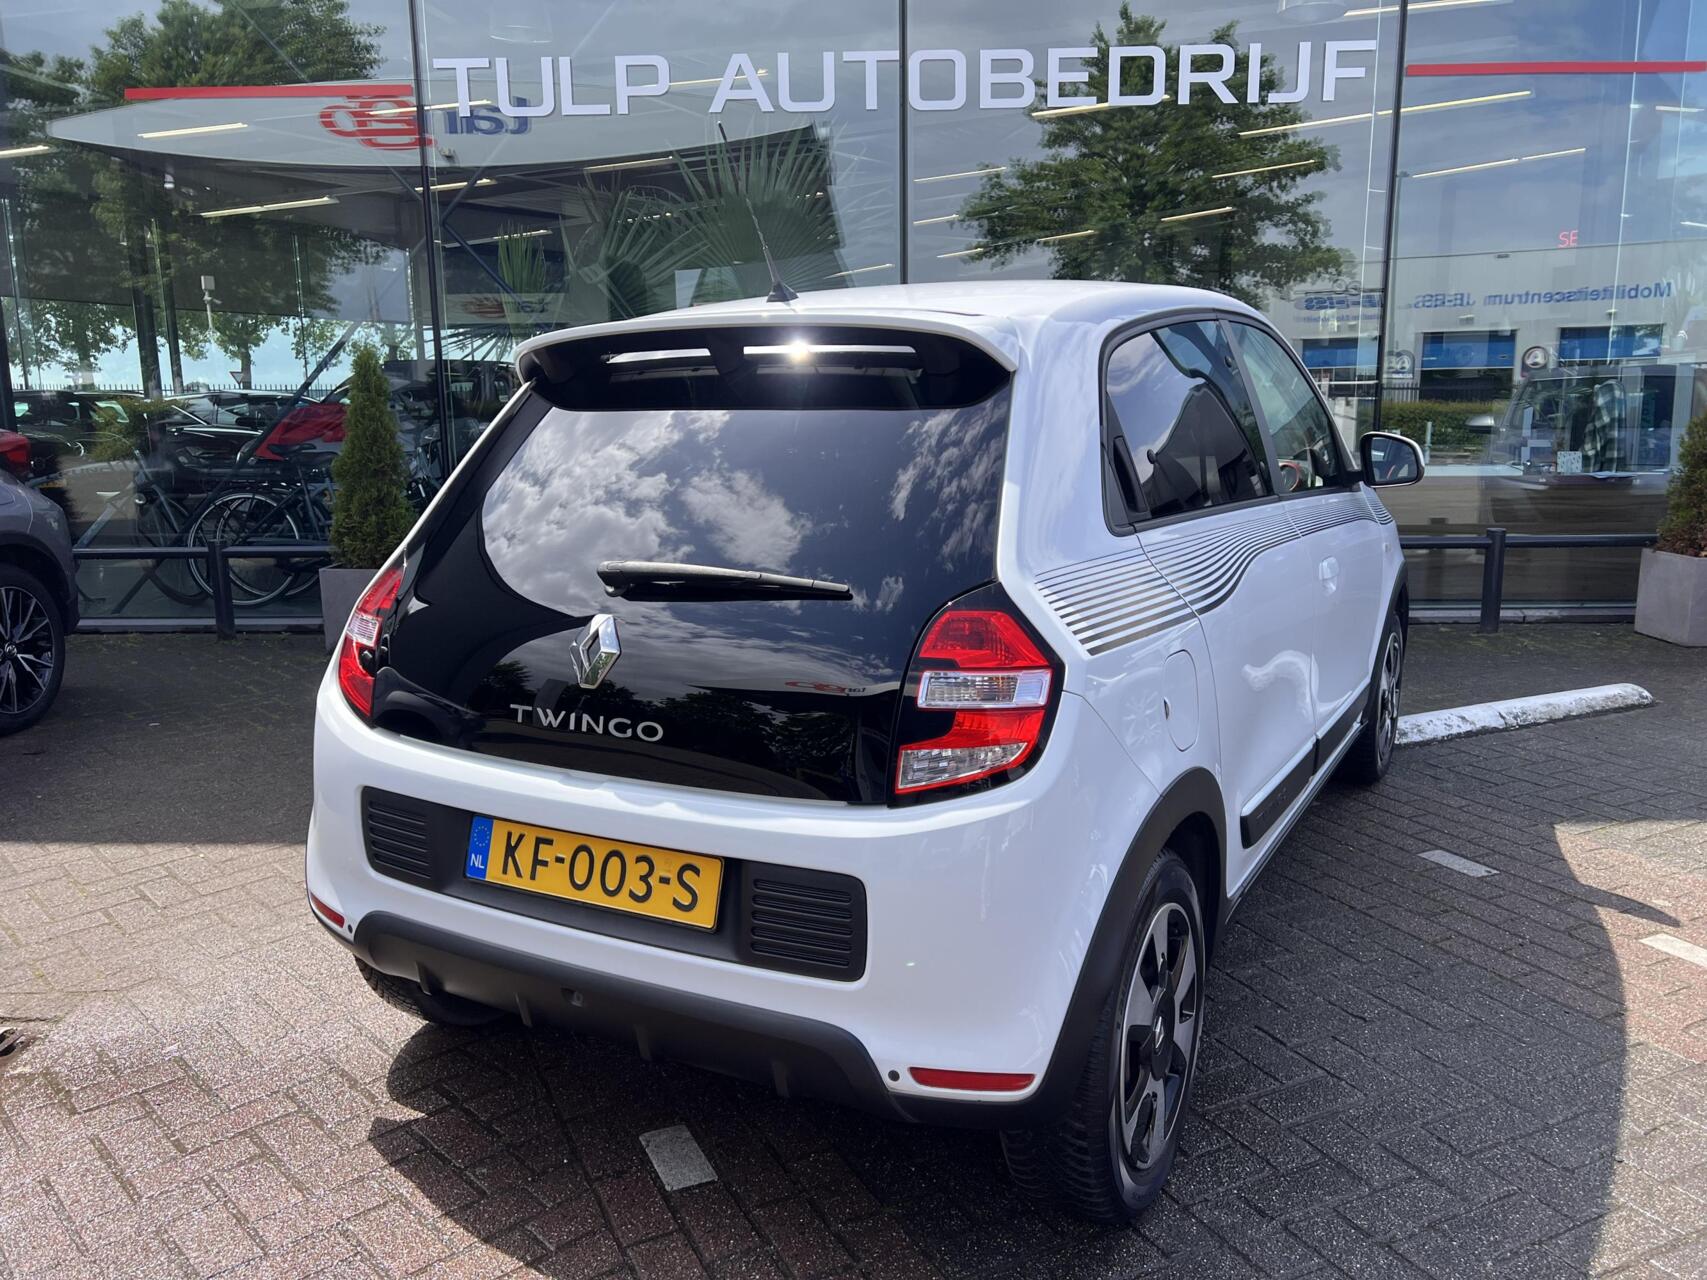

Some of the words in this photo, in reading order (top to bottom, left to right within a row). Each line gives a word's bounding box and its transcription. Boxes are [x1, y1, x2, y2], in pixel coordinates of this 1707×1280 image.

[432, 54, 671, 117] TULP
[708, 40, 1377, 113] AUTOBEDRIJF
[510, 703, 664, 742] TWINGO
[470, 852, 485, 870] NL
[502, 830, 701, 913] KF-003-S
